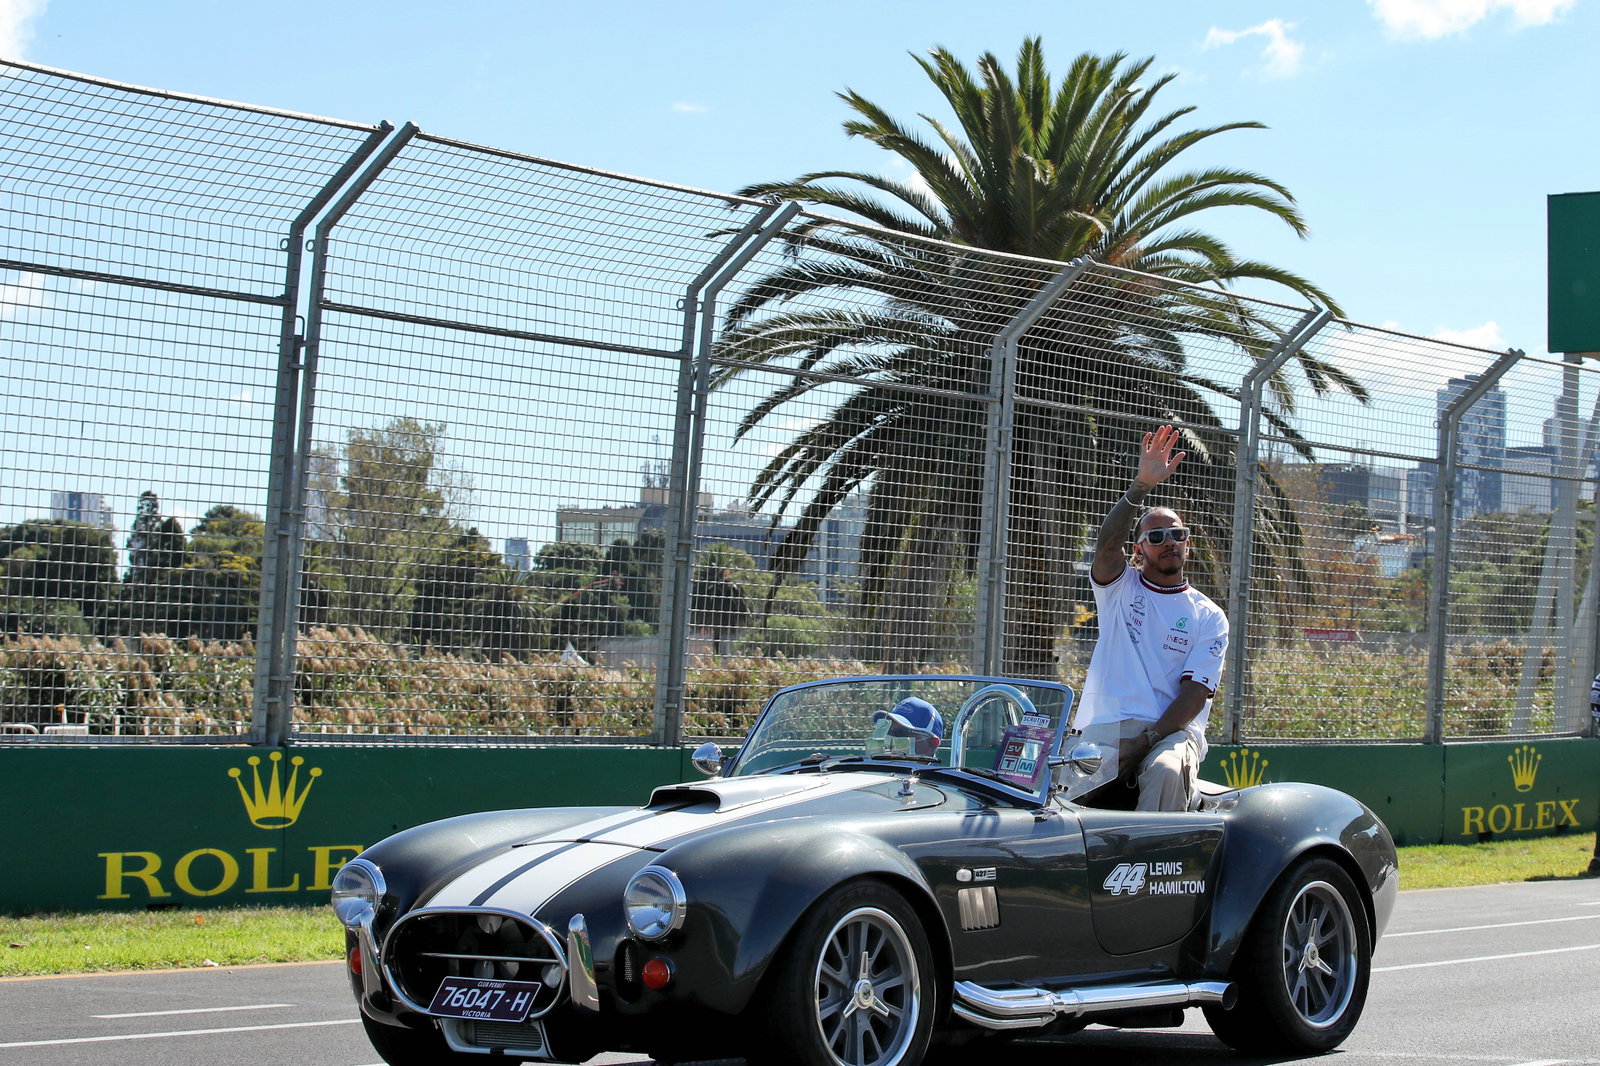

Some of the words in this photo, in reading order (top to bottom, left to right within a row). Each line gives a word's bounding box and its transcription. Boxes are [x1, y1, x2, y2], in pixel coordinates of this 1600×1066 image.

[1008, 745, 1022, 753] SV
[1461, 799, 1580, 835] ROLEX
[97, 845, 364, 899] ROLE
[1149, 862, 1183, 876] LEWIS
[1103, 863, 1148, 895] 44
[1149, 880, 1205, 895] HAMILTON
[462, 1010, 491, 1018] VICTORIA
